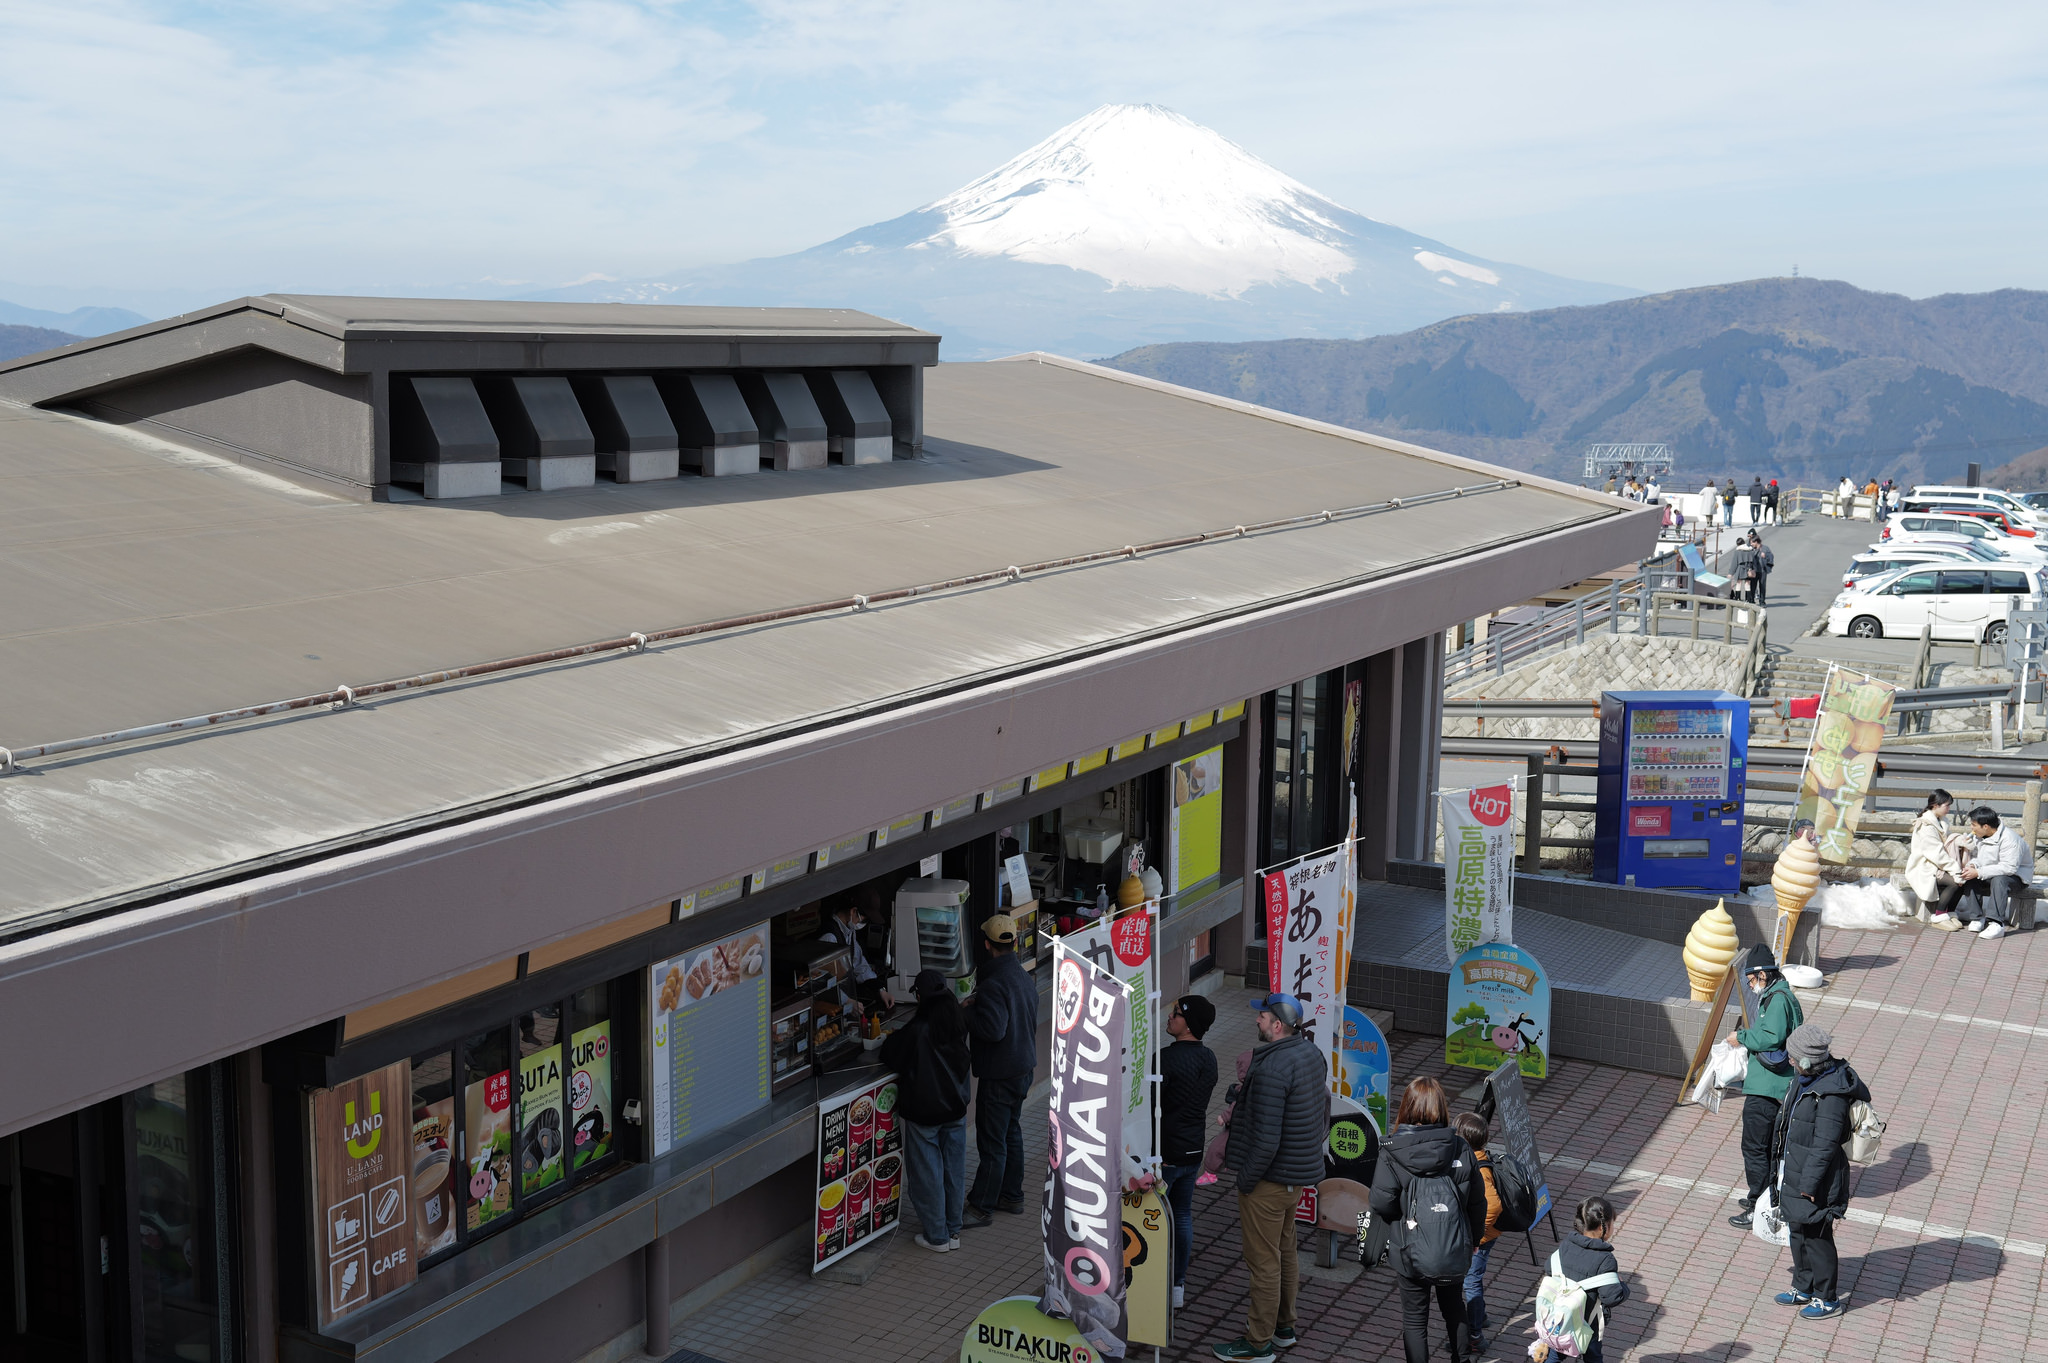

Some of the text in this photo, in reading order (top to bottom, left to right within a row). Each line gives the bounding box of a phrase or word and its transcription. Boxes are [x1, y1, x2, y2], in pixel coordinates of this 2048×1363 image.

[1472, 794, 1508, 818] HOT
[1637, 817, 1660, 826] Wonda
[1120, 917, 1148, 937] 産地
[1119, 938, 1145, 956] 直送
[1482, 984, 1499, 992] Fresh
[520, 1060, 560, 1096] BUTA
[343, 1113, 383, 1142] LAND
[825, 1107, 847, 1128] DRINK
[825, 1121, 845, 1141] MENU
[372, 1247, 407, 1276] CAFE
